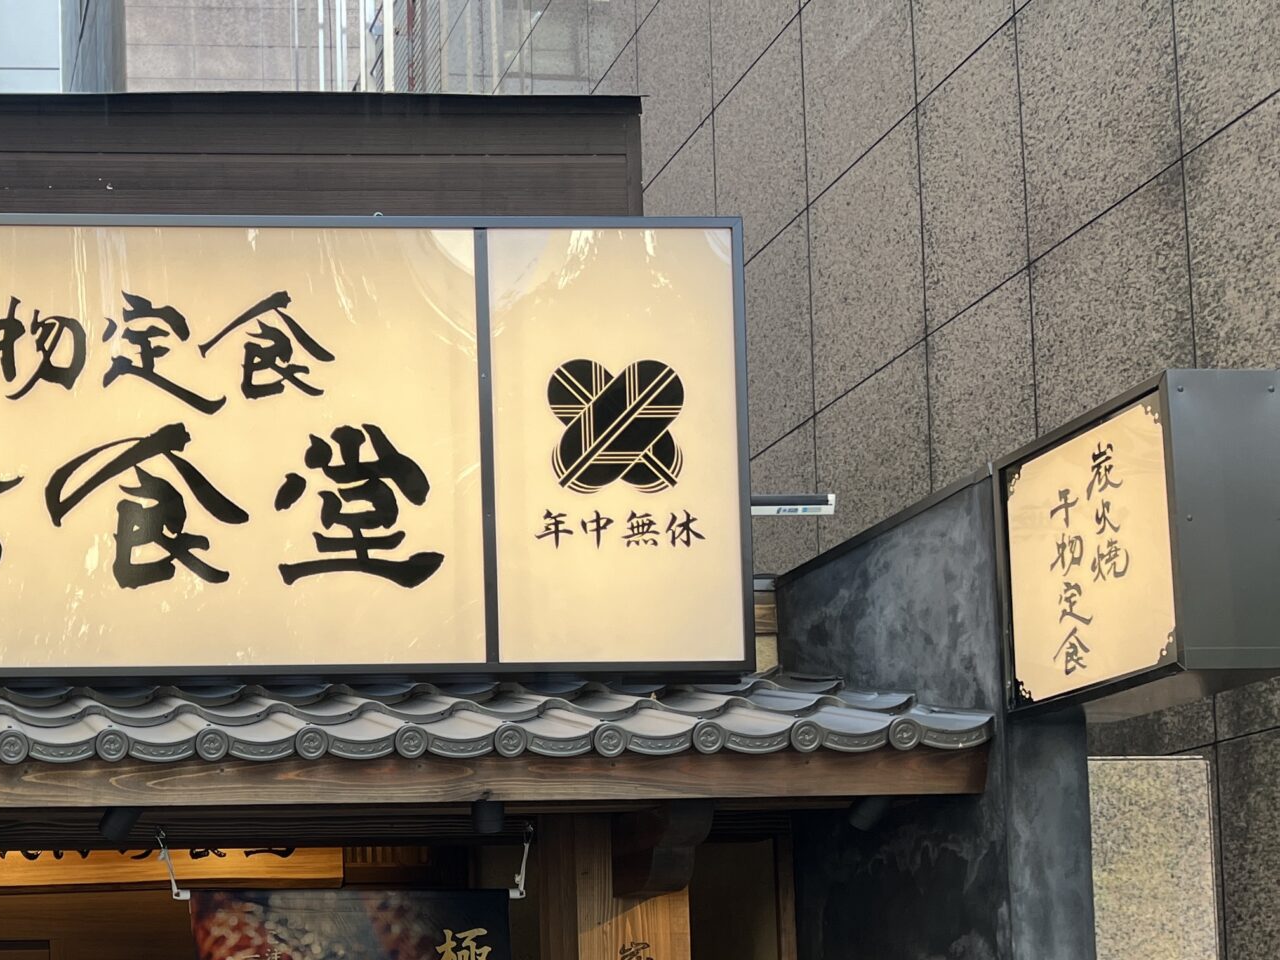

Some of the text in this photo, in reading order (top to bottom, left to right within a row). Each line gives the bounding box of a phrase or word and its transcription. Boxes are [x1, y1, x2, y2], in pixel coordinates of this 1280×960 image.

[534, 508, 707, 549] 年中無休
[1050, 488, 1093, 676] 干物定食
[1086, 441, 1129, 582] 炭火焼
